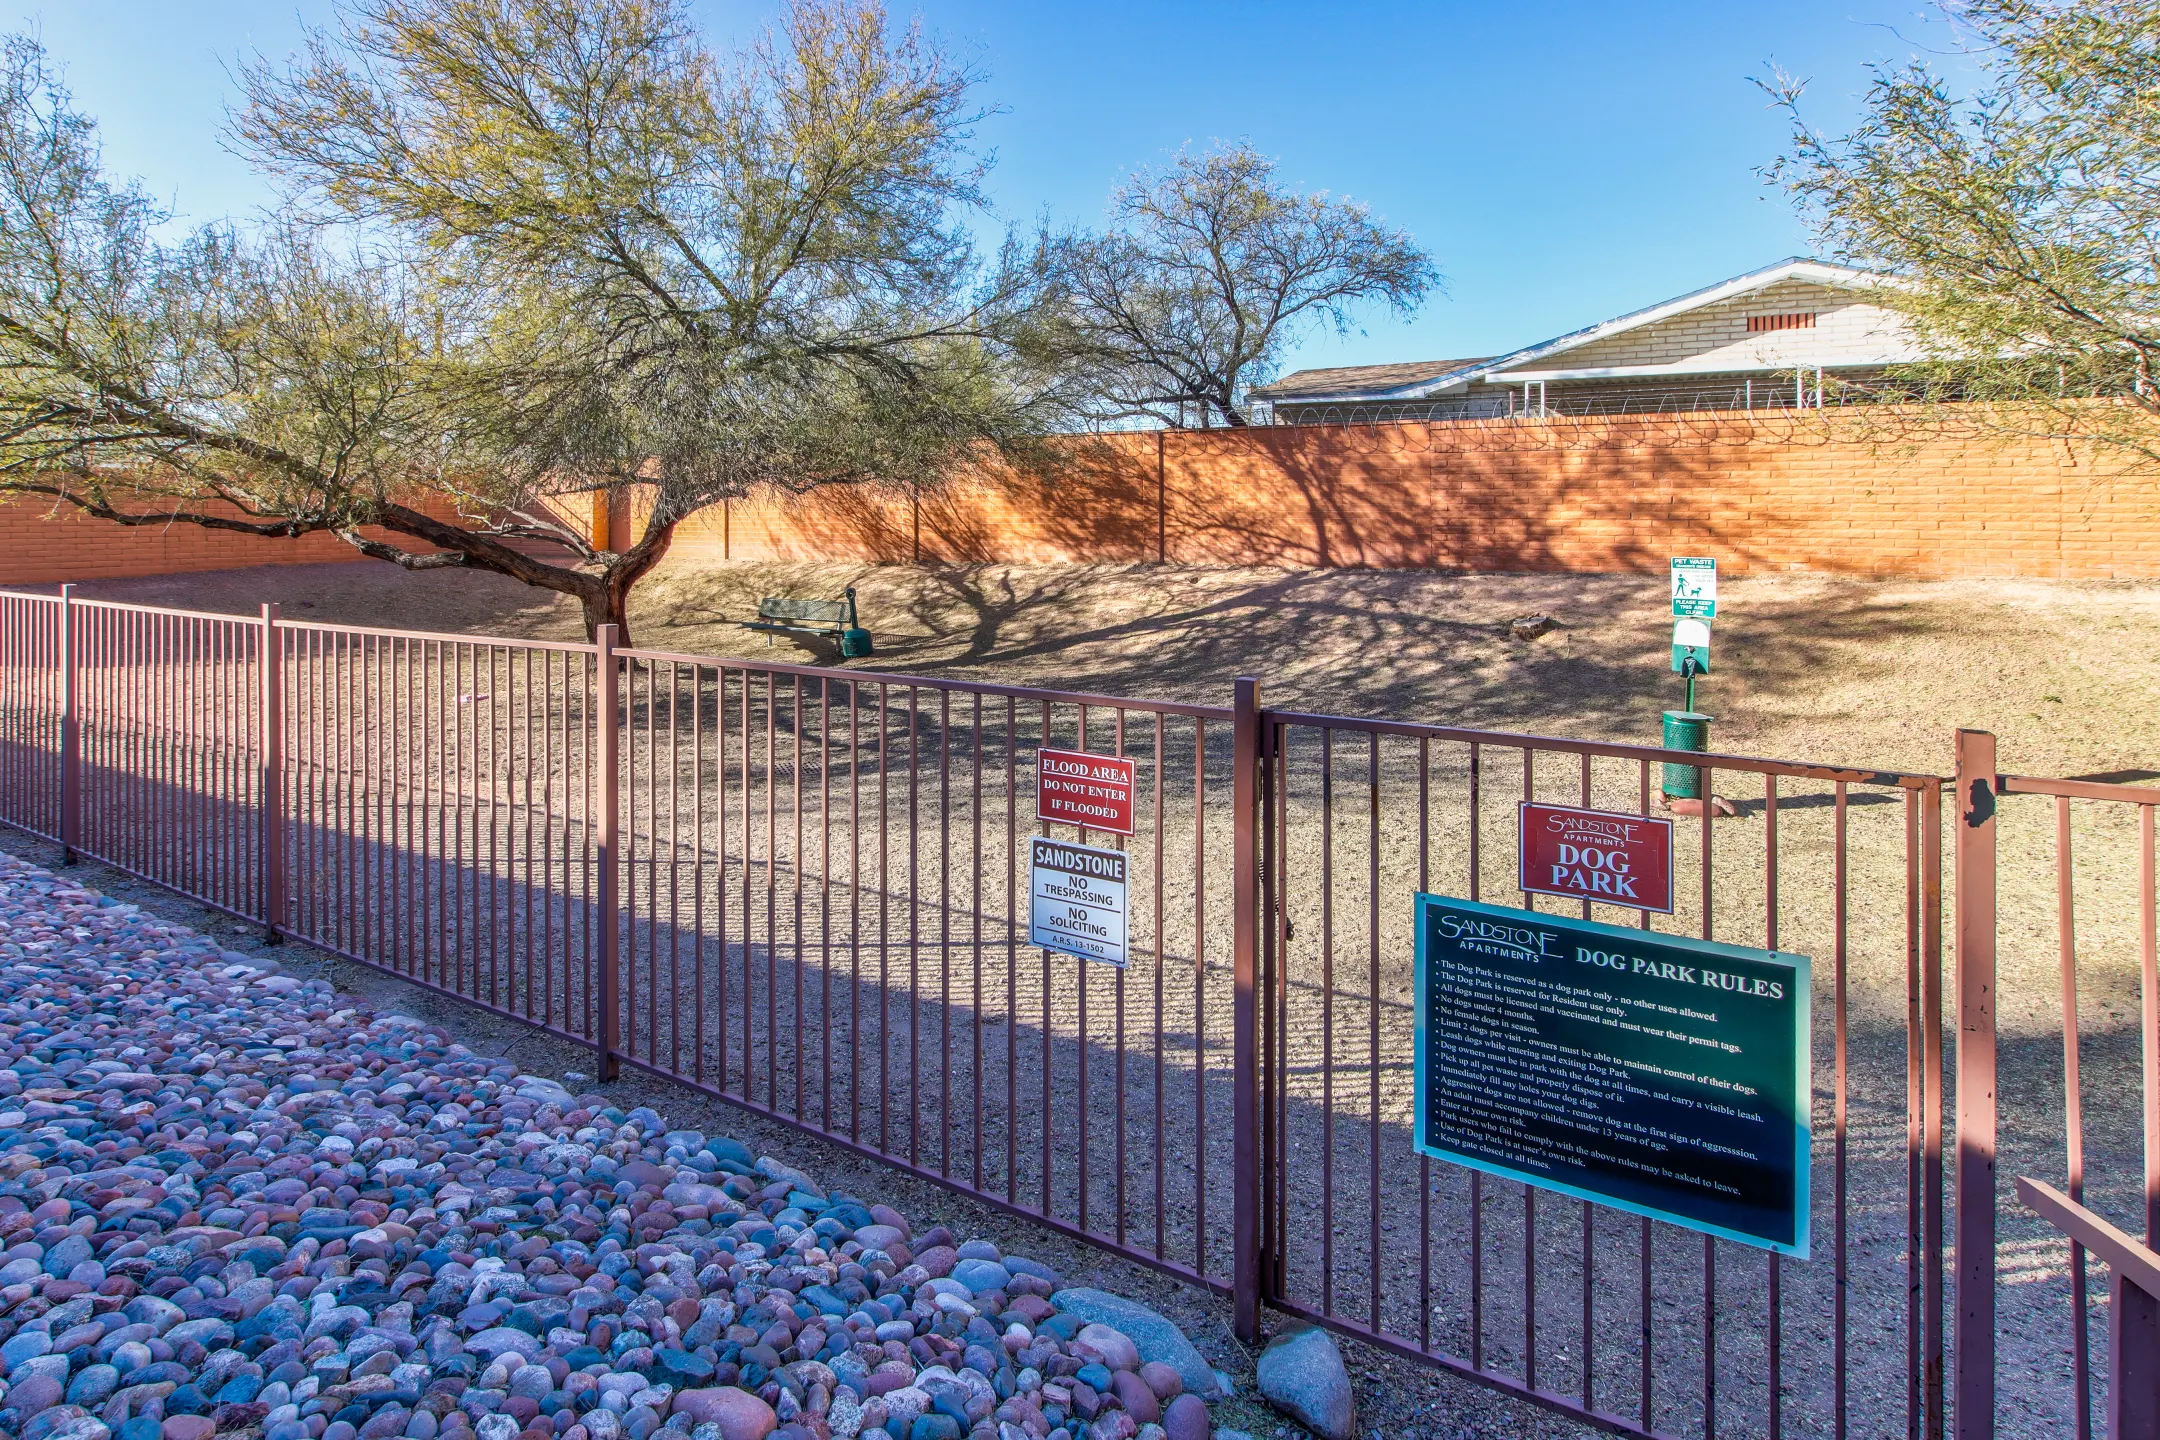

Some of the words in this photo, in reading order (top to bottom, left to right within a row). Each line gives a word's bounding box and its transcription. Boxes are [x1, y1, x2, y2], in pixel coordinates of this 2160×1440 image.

[1042, 758, 1088, 776] FLOOD
[1091, 766, 1129, 782] AREA
[1044, 778, 1060, 790] DO
[1062, 782, 1086, 794] NOT
[1088, 786, 1126, 802] ENTER
[1051, 798, 1062, 810] IF
[1064, 801, 1118, 818] FLOODED
[1547, 815, 1643, 843] SANDSTONE
[1564, 833, 1625, 848] APARTMENTS
[1036, 846, 1122, 879] SANDSTONE
[1558, 843, 1630, 874] DOG
[1044, 883, 1113, 906] TRESPASSING
[1068, 876, 1088, 890] NO
[1550, 864, 1640, 899] PARK
[1050, 916, 1107, 937] SOLICITING
[1068, 906, 1088, 921] NO
[1052, 935, 1072, 946] A.R.S.
[1074, 940, 1104, 954] 13-1502
[1438, 915, 1564, 959] SANDSTONE
[1460, 940, 1539, 963] APARTMENTS
[1576, 946, 1626, 970] DOG
[1632, 957, 1696, 983] PARK
[1701, 968, 1784, 1000] RULES
[1440, 959, 1455, 969] The
[1457, 962, 1473, 974] Dog
[1475, 966, 1492, 976] Park
[1494, 970, 1501, 978] is
[1503, 974, 1536, 985] reserved
[1555, 982, 1571, 994] dog
[1573, 988, 1591, 996] park
[1593, 992, 1612, 1002] only
[1633, 999, 1656, 1009] other
[1657, 1004, 1677, 1013] uses
[1679, 1008, 1717, 1021] allowed.
[1440, 971, 1455, 980] The
[1457, 974, 1473, 986] Dog
[1475, 978, 1492, 988] Park
[1503, 986, 1536, 997] reserved
[1538, 991, 1550, 1000] for
[1552, 994, 1587, 1008] Resident
[1605, 1006, 1626, 1017] only.
[1440, 994, 1452, 1003] No
[1453, 997, 1471, 1008] dogs
[1473, 1003, 1495, 1012] under
[1504, 1010, 1535, 1021] months.
[1440, 983, 1452, 992] All
[1454, 986, 1472, 996] dogs
[1474, 991, 1492, 1000] must
[1494, 993, 1504, 1002] be
[1506, 996, 1537, 1009] licensed
[1556, 1009, 1600, 1022] vaccinated
[1601, 1018, 1617, 1026] and
[1619, 1022, 1640, 1031] must
[1642, 1026, 1664, 1036] wear
[1666, 1030, 1687, 1041] their
[1688, 1036, 1718, 1047] permit
[1720, 1042, 1741, 1053] tags.
[1440, 1005, 1452, 1014] No
[1454, 1009, 1479, 1020] female
[1480, 1015, 1499, 1026] dogs
[1501, 1018, 1509, 1027] in
[1511, 1023, 1539, 1034] season.
[1440, 1028, 1462, 1040] Leash
[1464, 1034, 1482, 1045] dogs
[1484, 1040, 1505, 1050] while
[1507, 1046, 1539, 1060] entering
[1541, 1054, 1556, 1062] and
[1558, 1057, 1586, 1070] exiting
[1588, 1062, 1606, 1075] Dog
[1609, 1067, 1630, 1079] Park.
[1440, 1017, 1461, 1028] Limit
[1469, 1024, 1487, 1035] dogs
[1504, 1032, 1521, 1042] visit
[1528, 1039, 1557, 1050] owners
[1559, 1046, 1579, 1055] must
[1581, 1048, 1591, 1057] be
[1593, 1052, 1611, 1062] able
[1623, 1060, 1661, 1073] maintain
[1663, 1069, 1695, 1081] control
[1697, 1075, 1708, 1083] of
[1709, 1077, 1731, 1088] their
[1732, 1082, 1757, 1095] dogs.
[1440, 1052, 1457, 1062] Pick
[1458, 1058, 1468, 1066] up
[1470, 1060, 1479, 1068] all
[1495, 1066, 1517, 1076] waste
[1519, 1072, 1534, 1081] and
[1536, 1076, 1569, 1090] properly
[1571, 1083, 1602, 1097] dispose
[1616, 1093, 1624, 1102] it.
[1440, 1040, 1456, 1052] Dog
[1458, 1046, 1485, 1057] owners
[1487, 1053, 1506, 1062] must
[1508, 1056, 1517, 1065] be
[1519, 1058, 1527, 1067] in
[1529, 1063, 1547, 1072] park
[1549, 1067, 1567, 1076] with
[1569, 1071, 1582, 1080] the
[1584, 1074, 1600, 1086] dog
[1611, 1081, 1622, 1089] all
[1625, 1083, 1650, 1096] times,
[1652, 1092, 1669, 1100] and
[1671, 1096, 1694, 1107] carry
[1704, 1102, 1734, 1115] visible
[1737, 1109, 1763, 1122] leash.
[1440, 1076, 1482, 1091] Aggressive
[1483, 1086, 1502, 1097] dogs
[1518, 1096, 1530, 1104] not
[1532, 1099, 1564, 1112] allowed
[1572, 1109, 1603, 1121] remove
[1605, 1116, 1621, 1128] dog
[1633, 1123, 1647, 1132] the
[1649, 1126, 1666, 1138] first
[1669, 1132, 1687, 1143] sign
[1440, 1132, 1460, 1145] Keep
[1461, 1140, 1477, 1149] gate
[1479, 1144, 1503, 1156] closed
[1514, 1154, 1524, 1162] all
[1527, 1157, 1550, 1169] times.
